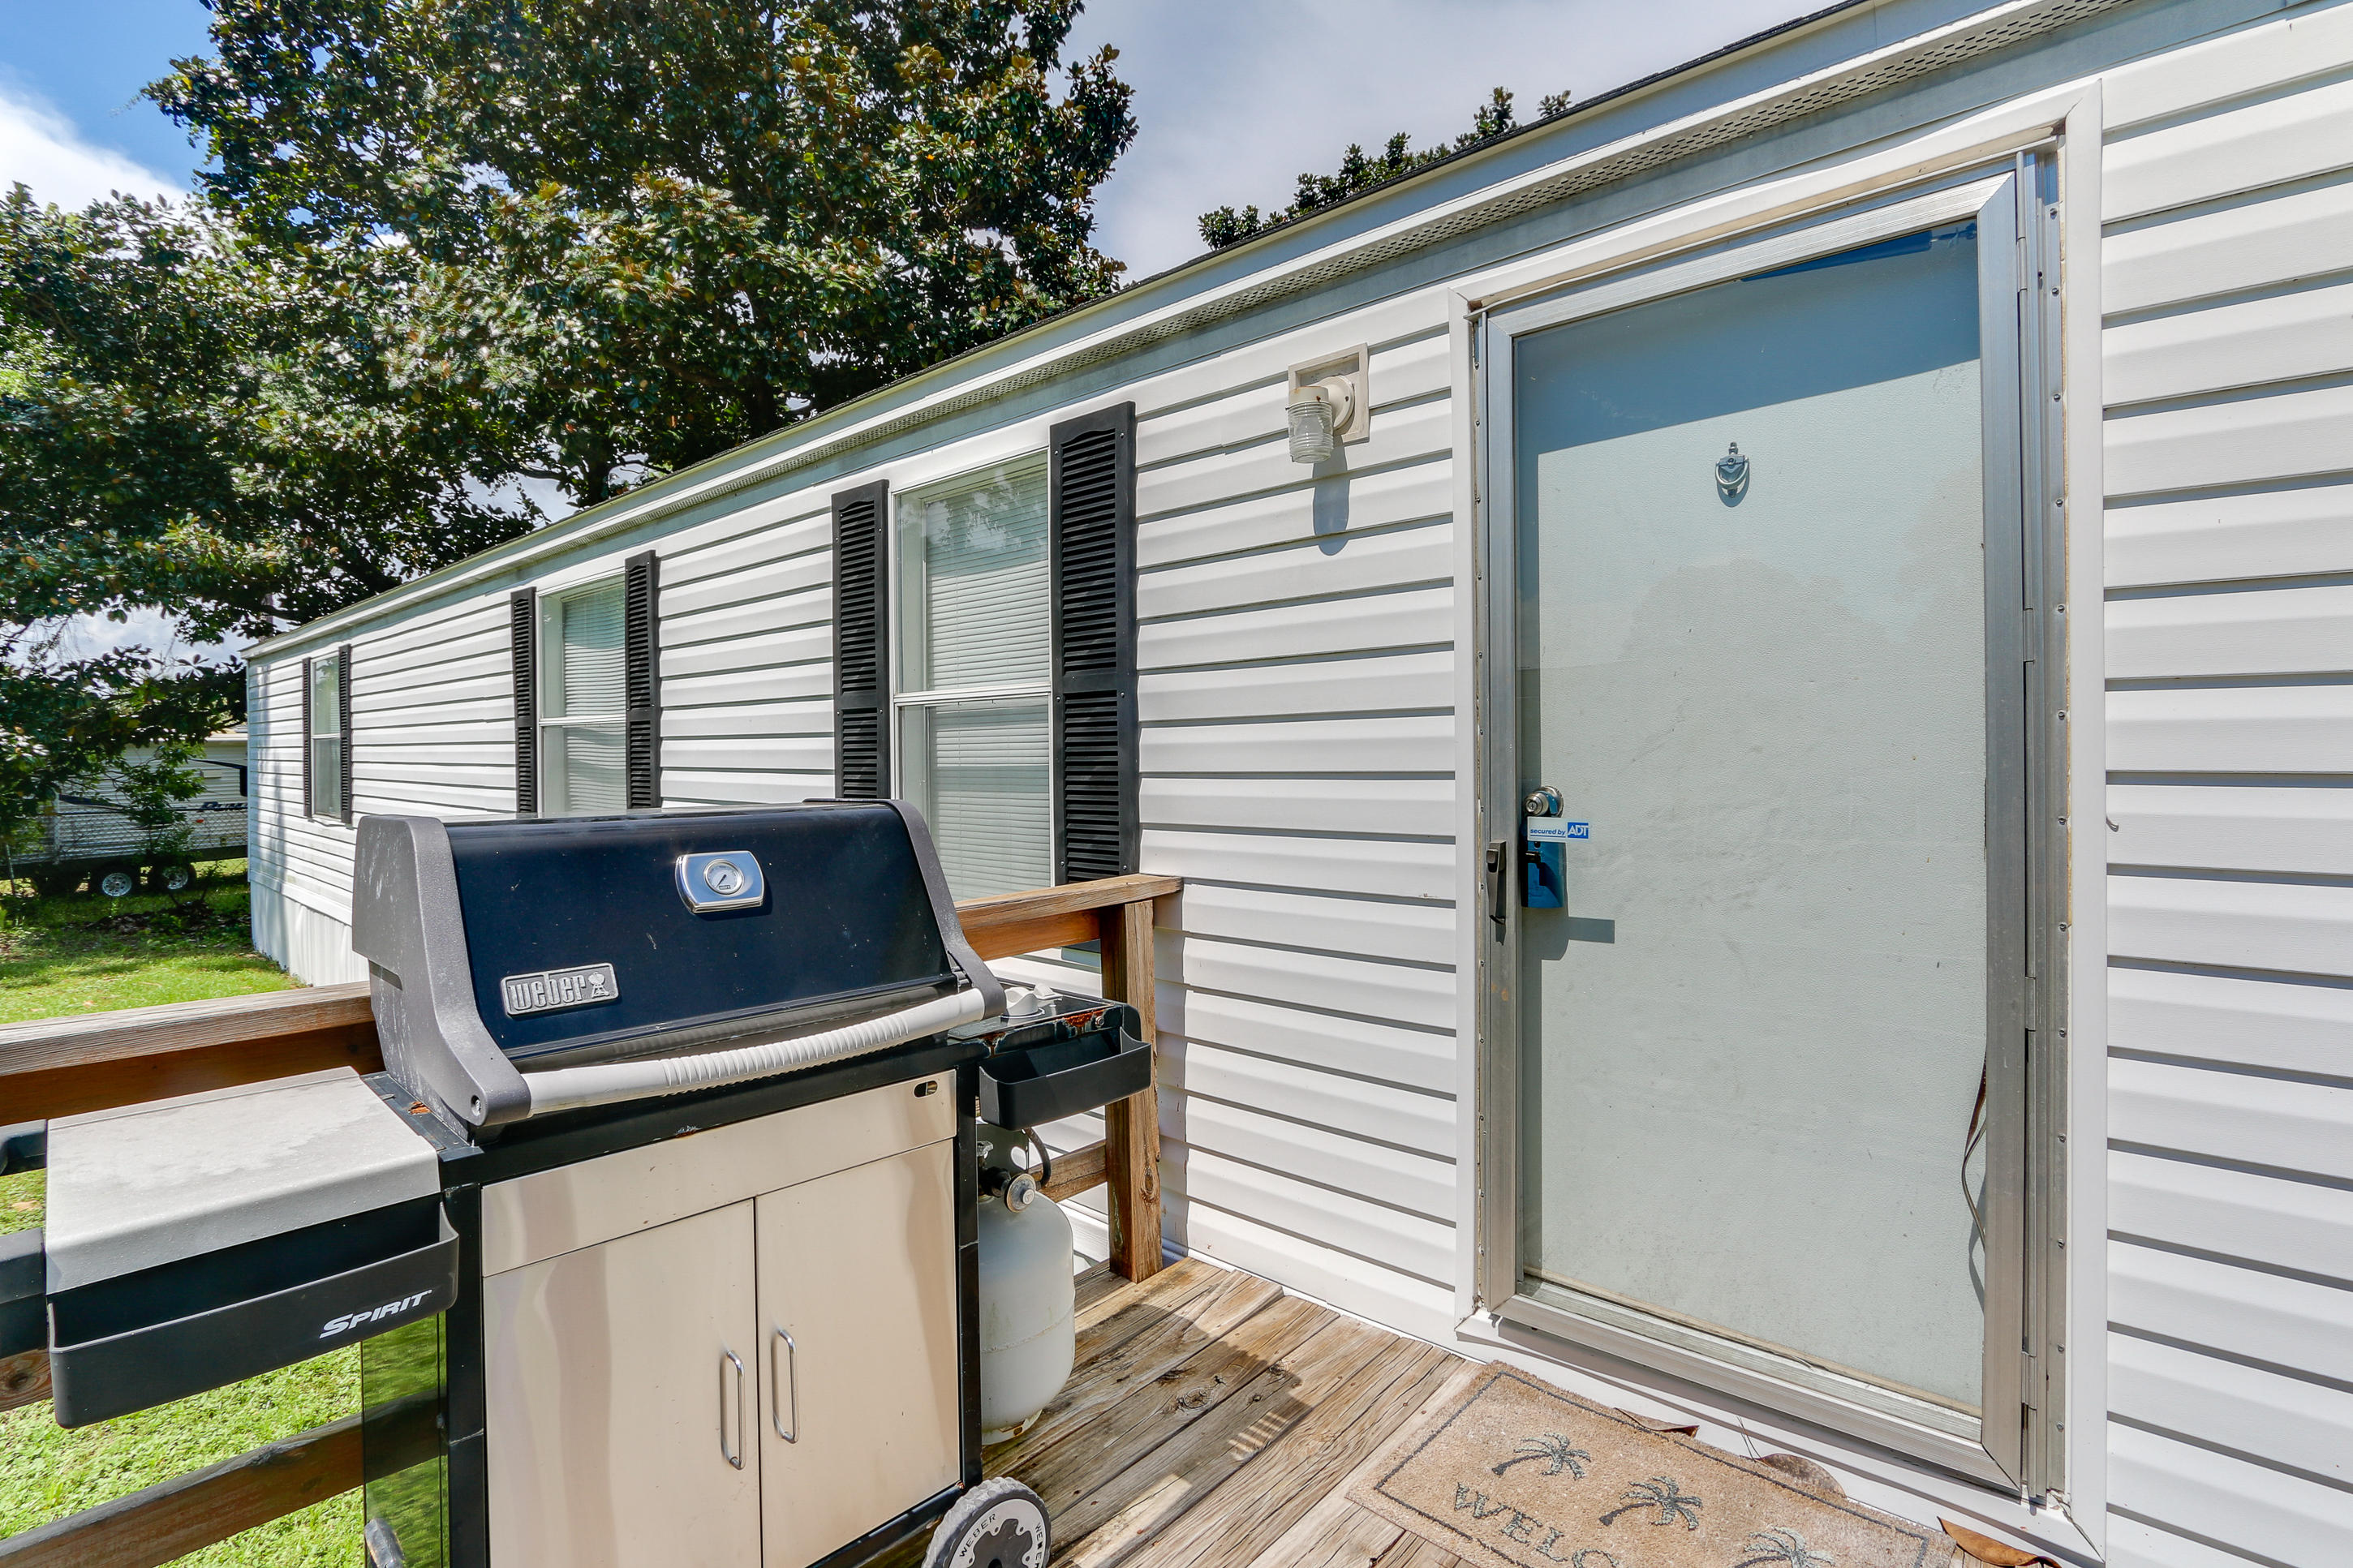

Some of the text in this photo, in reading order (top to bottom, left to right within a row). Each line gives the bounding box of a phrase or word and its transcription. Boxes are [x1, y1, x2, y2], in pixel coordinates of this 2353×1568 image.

[1557, 828, 1566, 836] by
[1568, 824, 1589, 836] ADT
[507, 973, 586, 1011] weber
[319, 1290, 432, 1339] SPIRIT
[959, 1513, 996, 1557] WEBER
